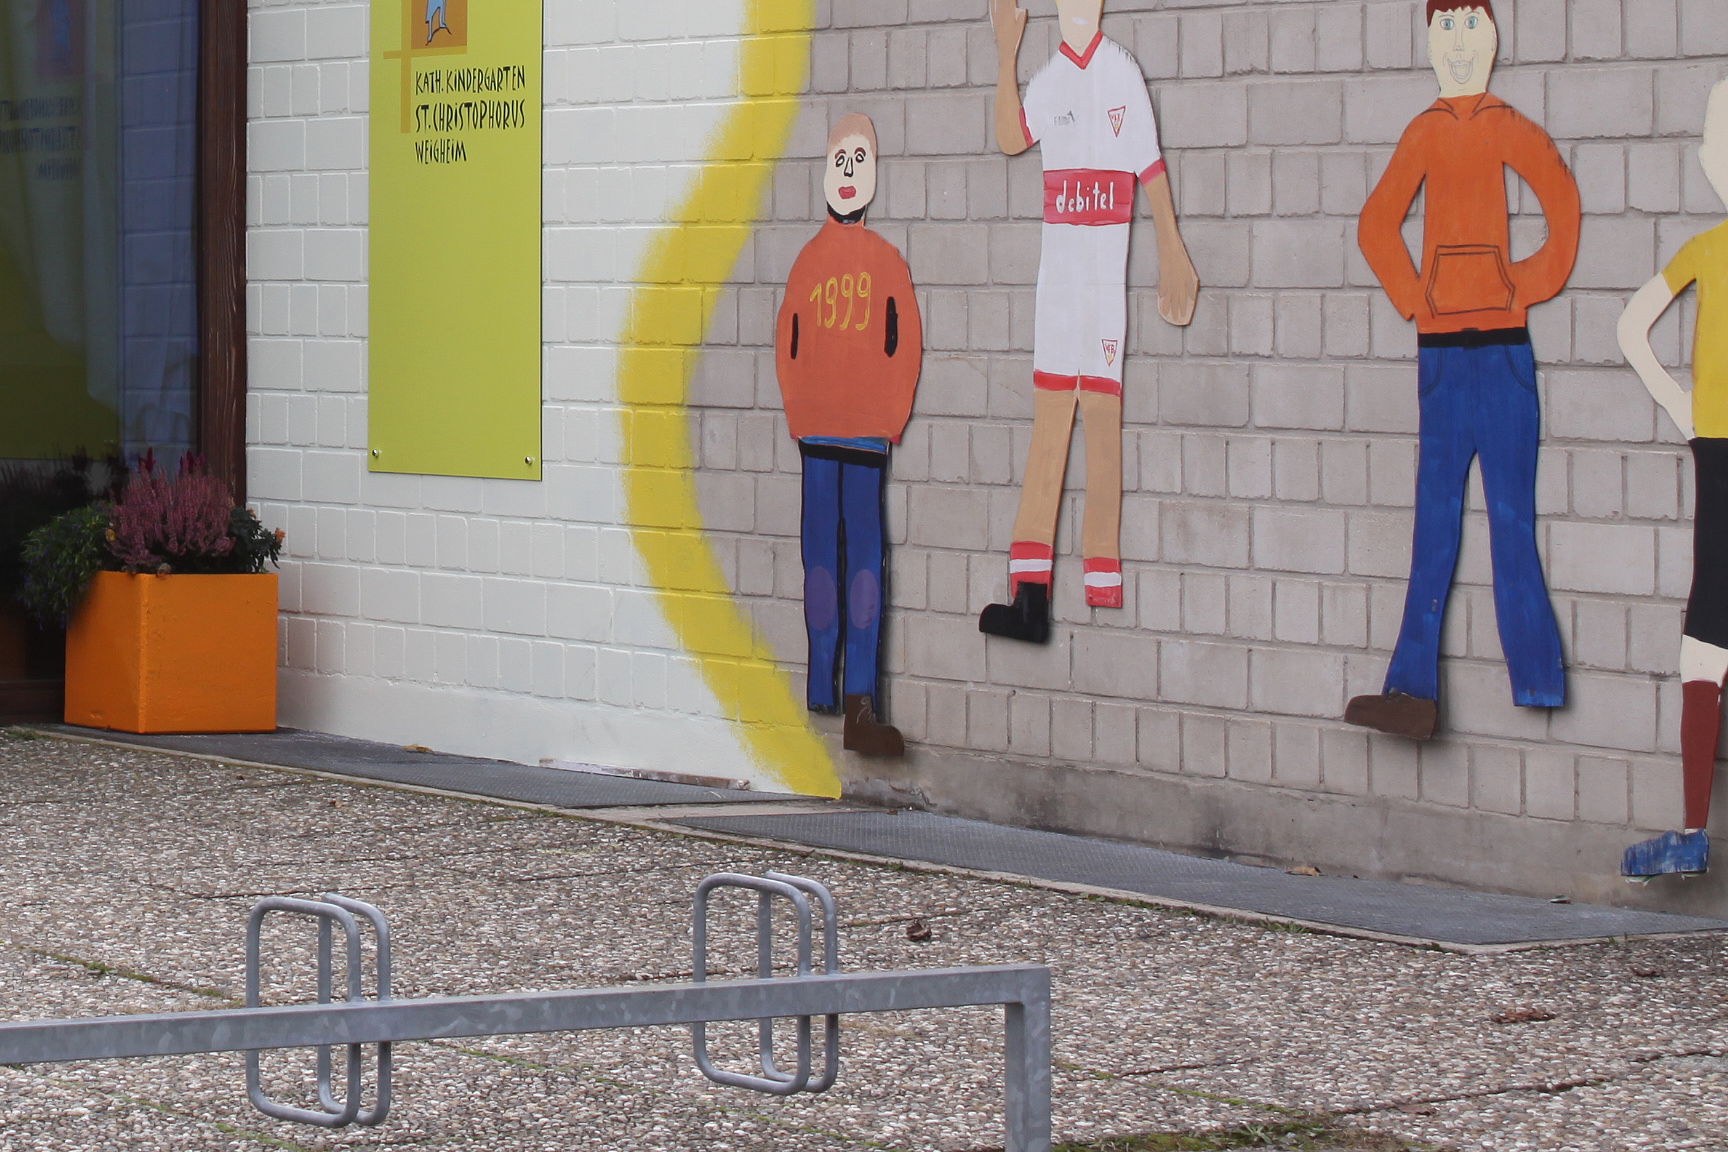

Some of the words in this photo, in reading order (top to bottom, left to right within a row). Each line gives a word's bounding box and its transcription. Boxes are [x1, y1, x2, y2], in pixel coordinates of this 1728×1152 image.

[415, 69, 444, 96] KATH.
[1055, 179, 1115, 214] debitel
[808, 270, 874, 332] 1999
